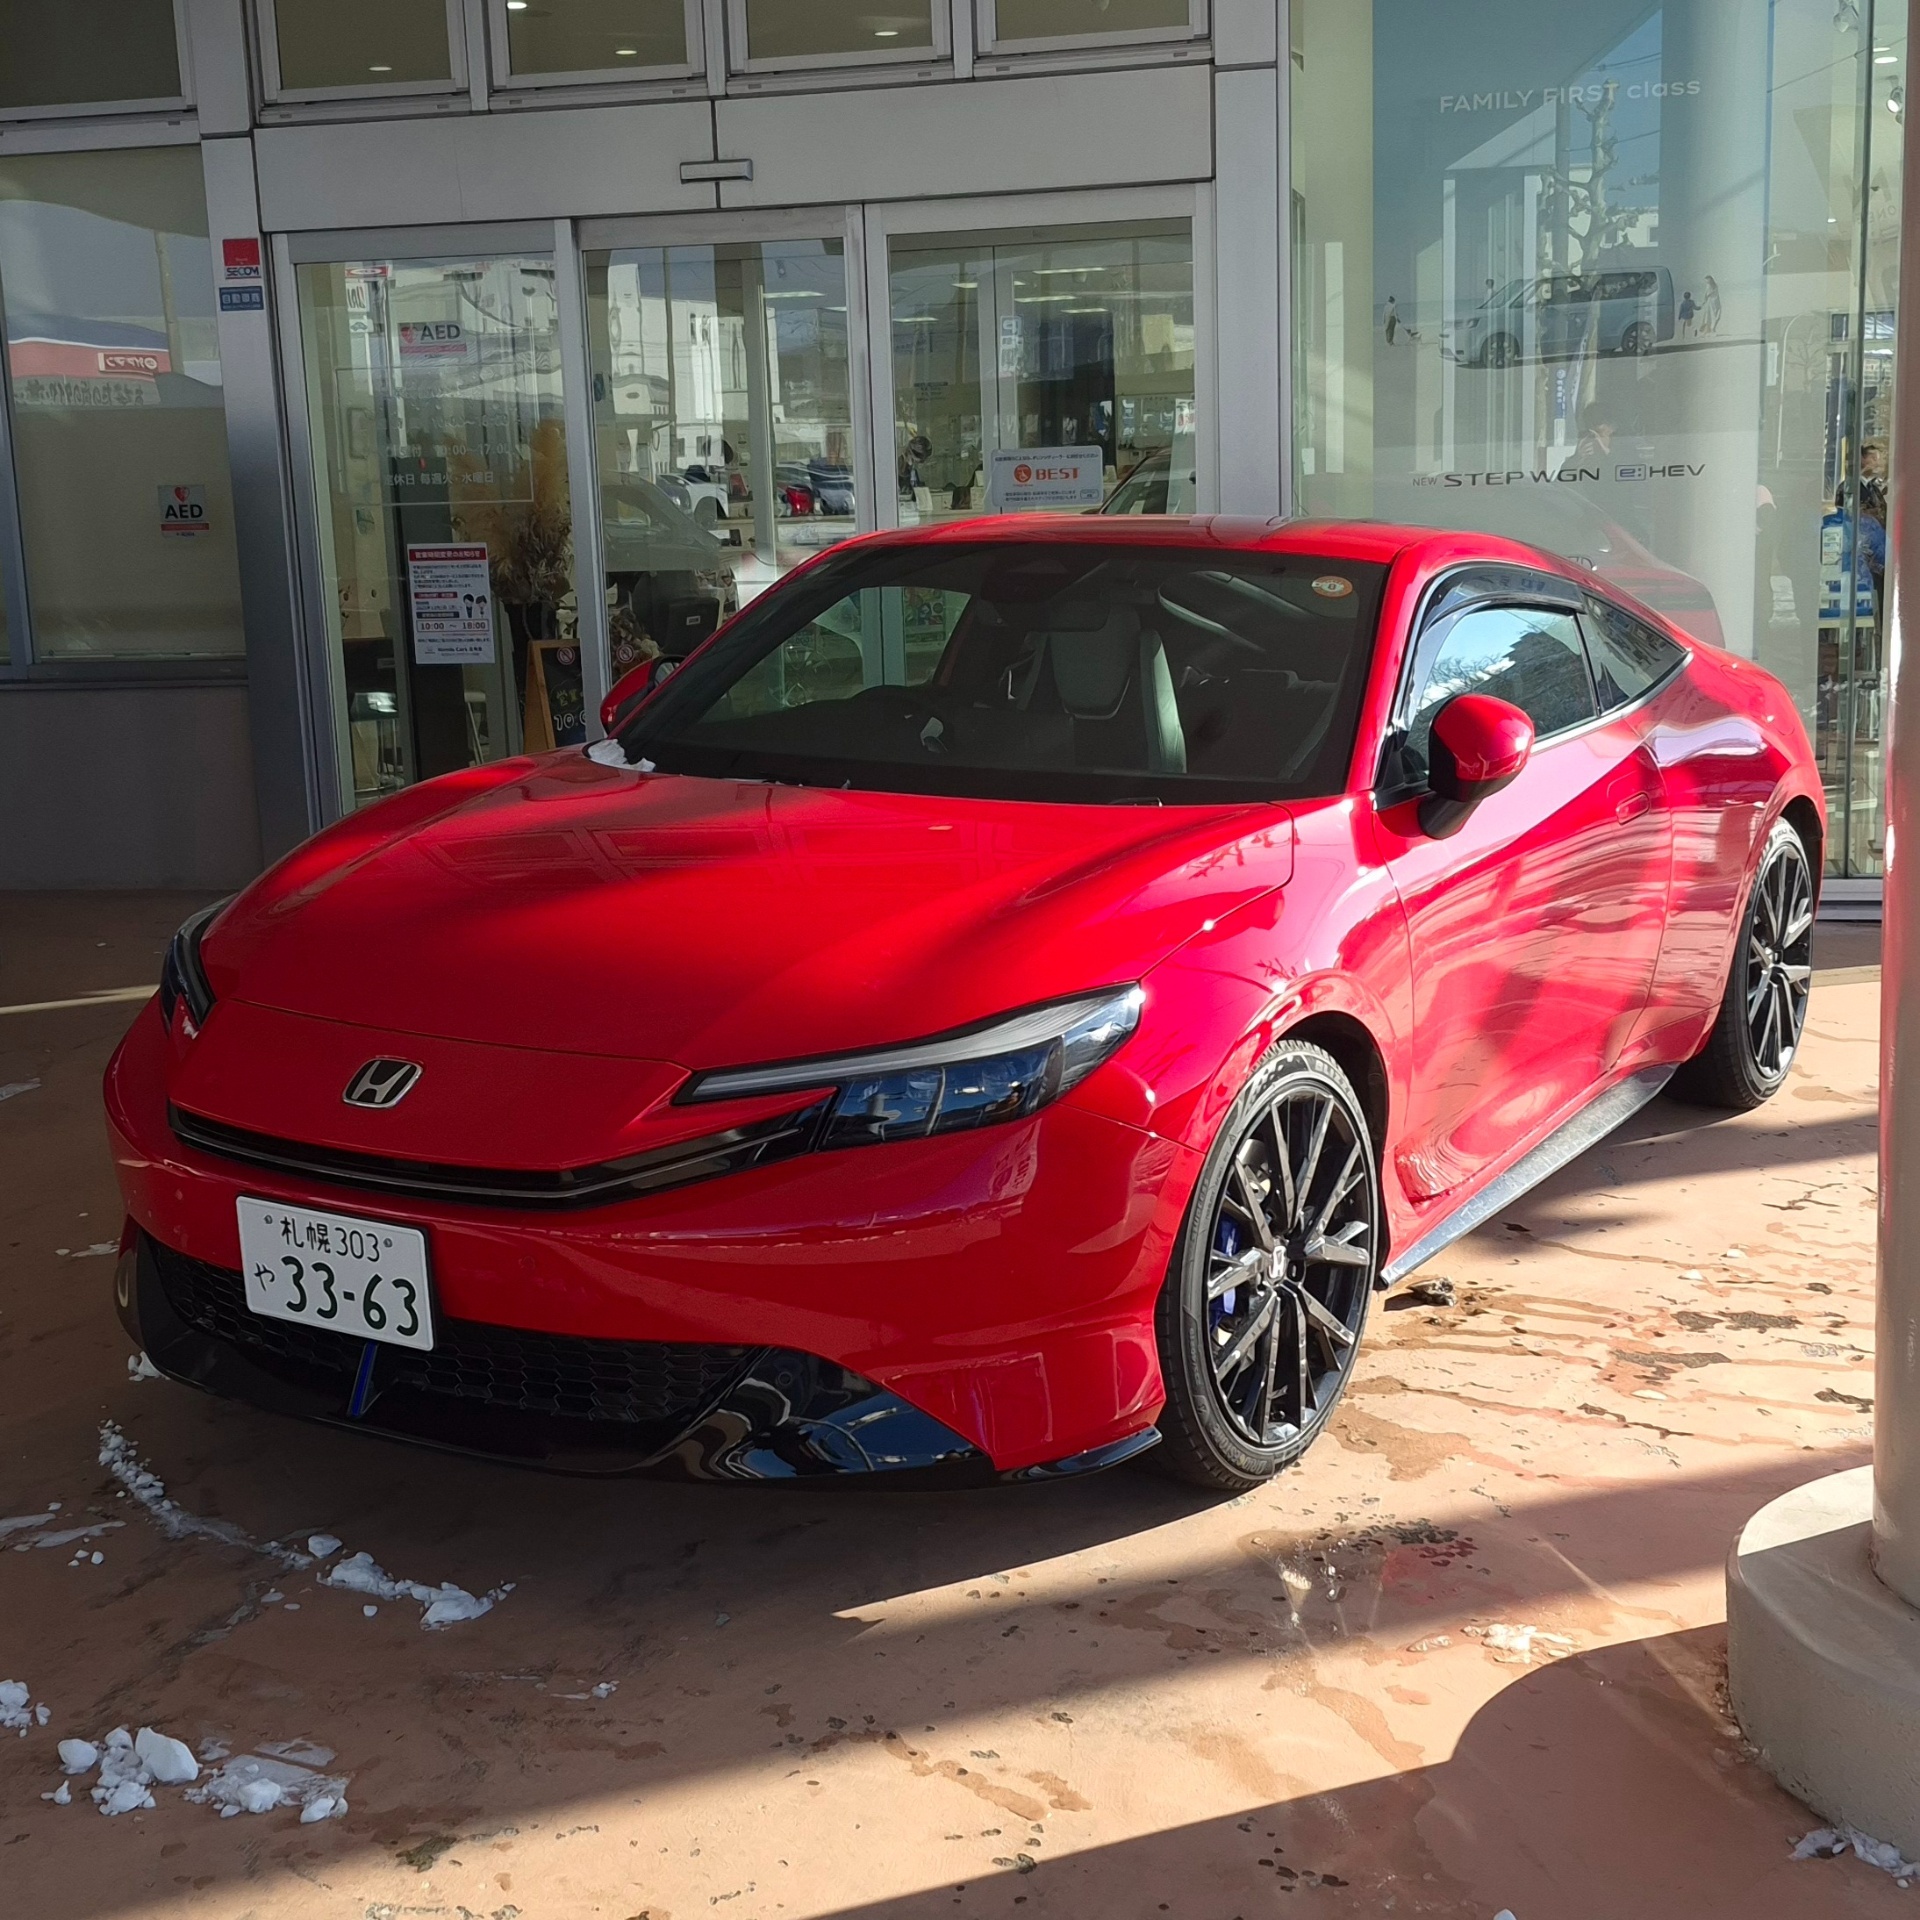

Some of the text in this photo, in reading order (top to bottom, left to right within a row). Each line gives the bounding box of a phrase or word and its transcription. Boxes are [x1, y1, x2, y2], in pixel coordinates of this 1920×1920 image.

[1439, 80, 1701, 113] FAMILY FIRST class
[226, 266, 260, 276] SECOM
[420, 324, 461, 341] AED
[1035, 466, 1080, 481] BEST
[1412, 476, 1438, 487] NEW
[164, 503, 204, 519] AED
[420, 622, 445, 630] 10:00
[462, 621, 486, 630] 18:00
[280, 1216, 381, 1263] 札幌 303
[254, 1255, 419, 1336] や 33-63
[1207, 1422, 1268, 1472] BRIDGESTONE
